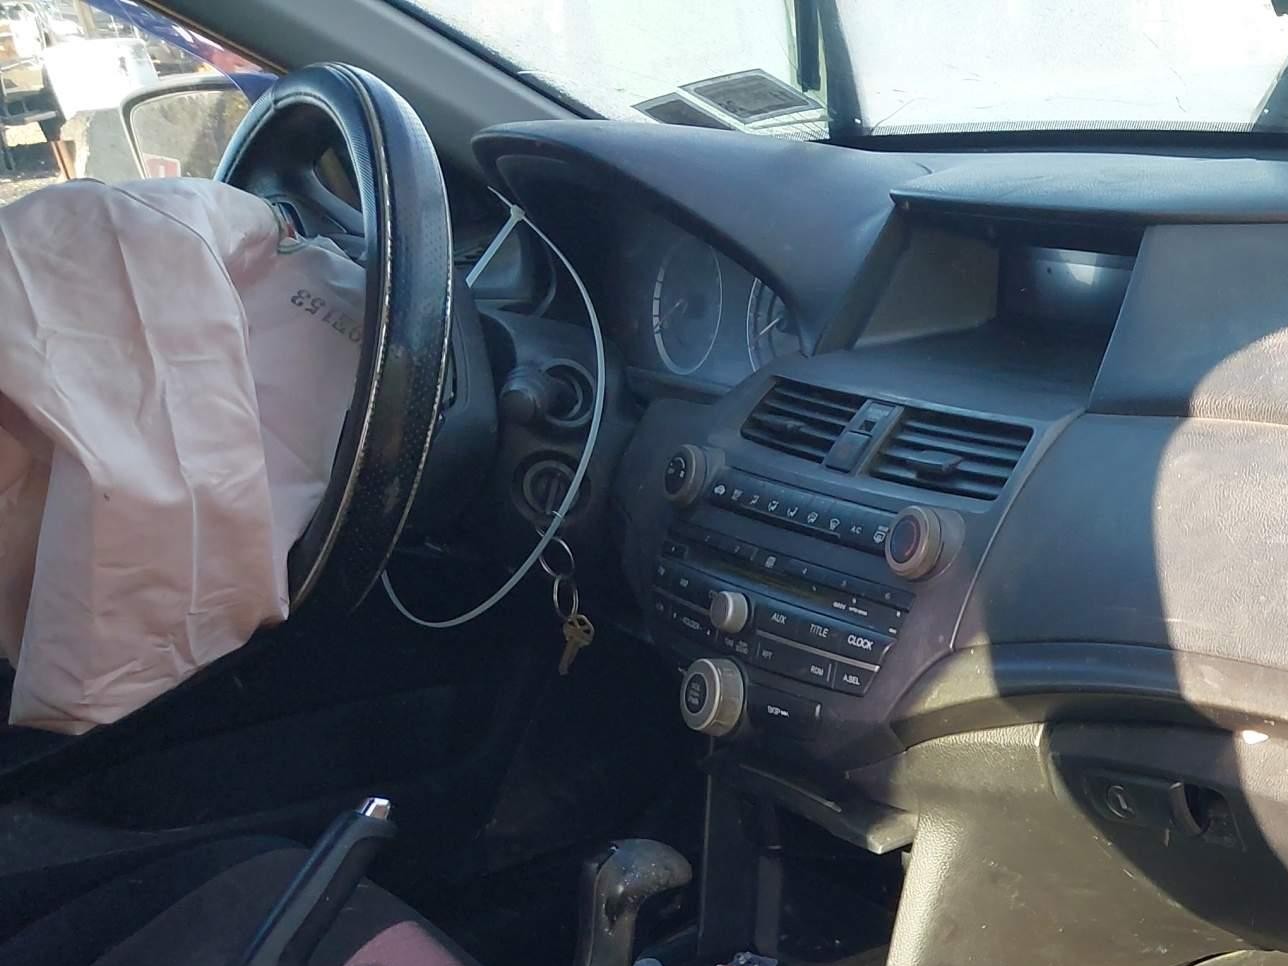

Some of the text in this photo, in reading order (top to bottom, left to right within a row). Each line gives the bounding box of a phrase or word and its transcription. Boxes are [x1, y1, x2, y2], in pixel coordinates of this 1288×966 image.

[771, 612, 787, 625] AUX
[809, 623, 829, 639] TITLE
[847, 634, 874, 651] CLOCK
